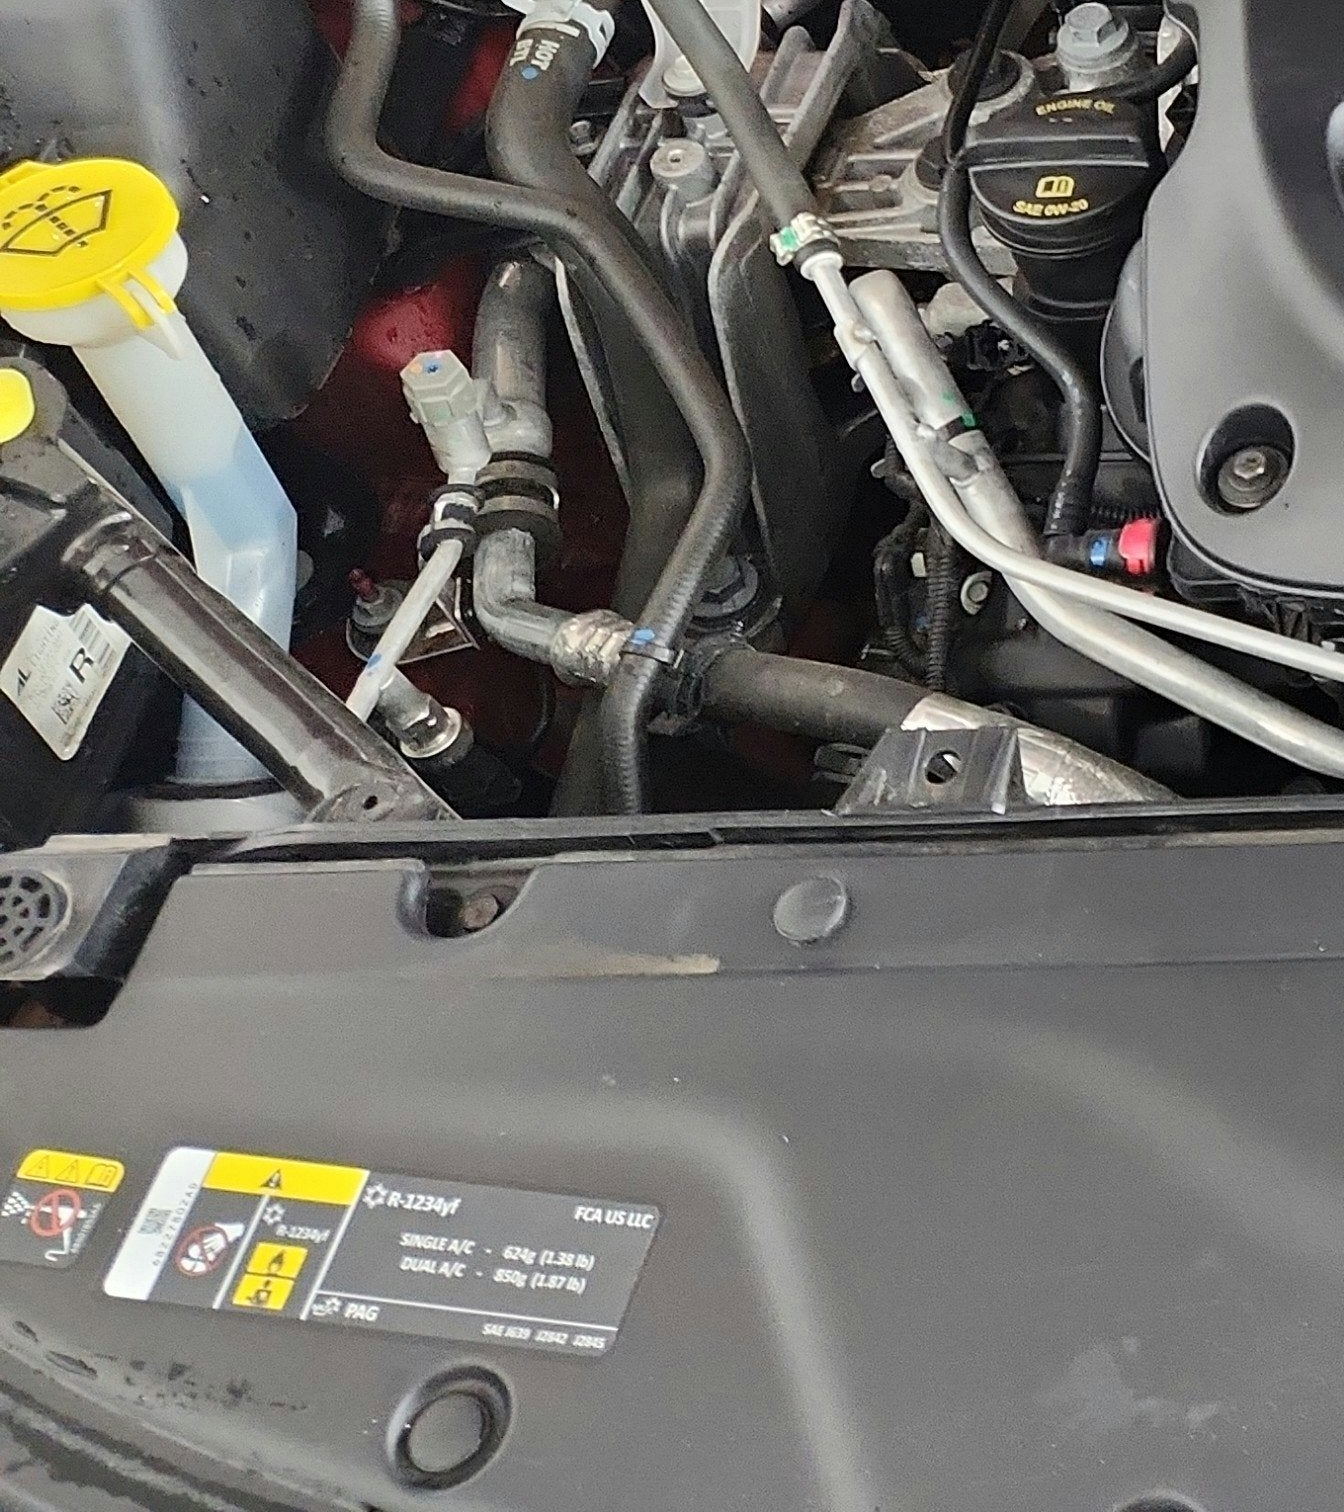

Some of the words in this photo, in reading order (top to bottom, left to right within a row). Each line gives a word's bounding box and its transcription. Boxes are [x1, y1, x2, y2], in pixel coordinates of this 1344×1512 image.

[531, 39, 560, 71] HOT
[1035, 98, 1093, 116] ENGINE
[1093, 99, 1116, 115] OIL
[1013, 200, 1044, 217] SAE
[1044, 198, 1089, 217] 0W-20
[69, 646, 94, 684] R
[386, 1190, 462, 1218] R-1234yf
[574, 1205, 601, 1223] FCA
[605, 1209, 626, 1226] US
[627, 1212, 655, 1229] LLC
[400, 1233, 448, 1253] SINGLE
[448, 1239, 476, 1256] A/C
[502, 1245, 537, 1266] 624g
[539, 1250, 575, 1268] (1.38
[575, 1254, 595, 1272] lb)
[400, 1256, 437, 1274] DUAL
[438, 1260, 467, 1278] A/C
[493, 1268, 528, 1288] 850g
[568, 1277, 587, 1296] lb)
[344, 1302, 380, 1322] PAG
